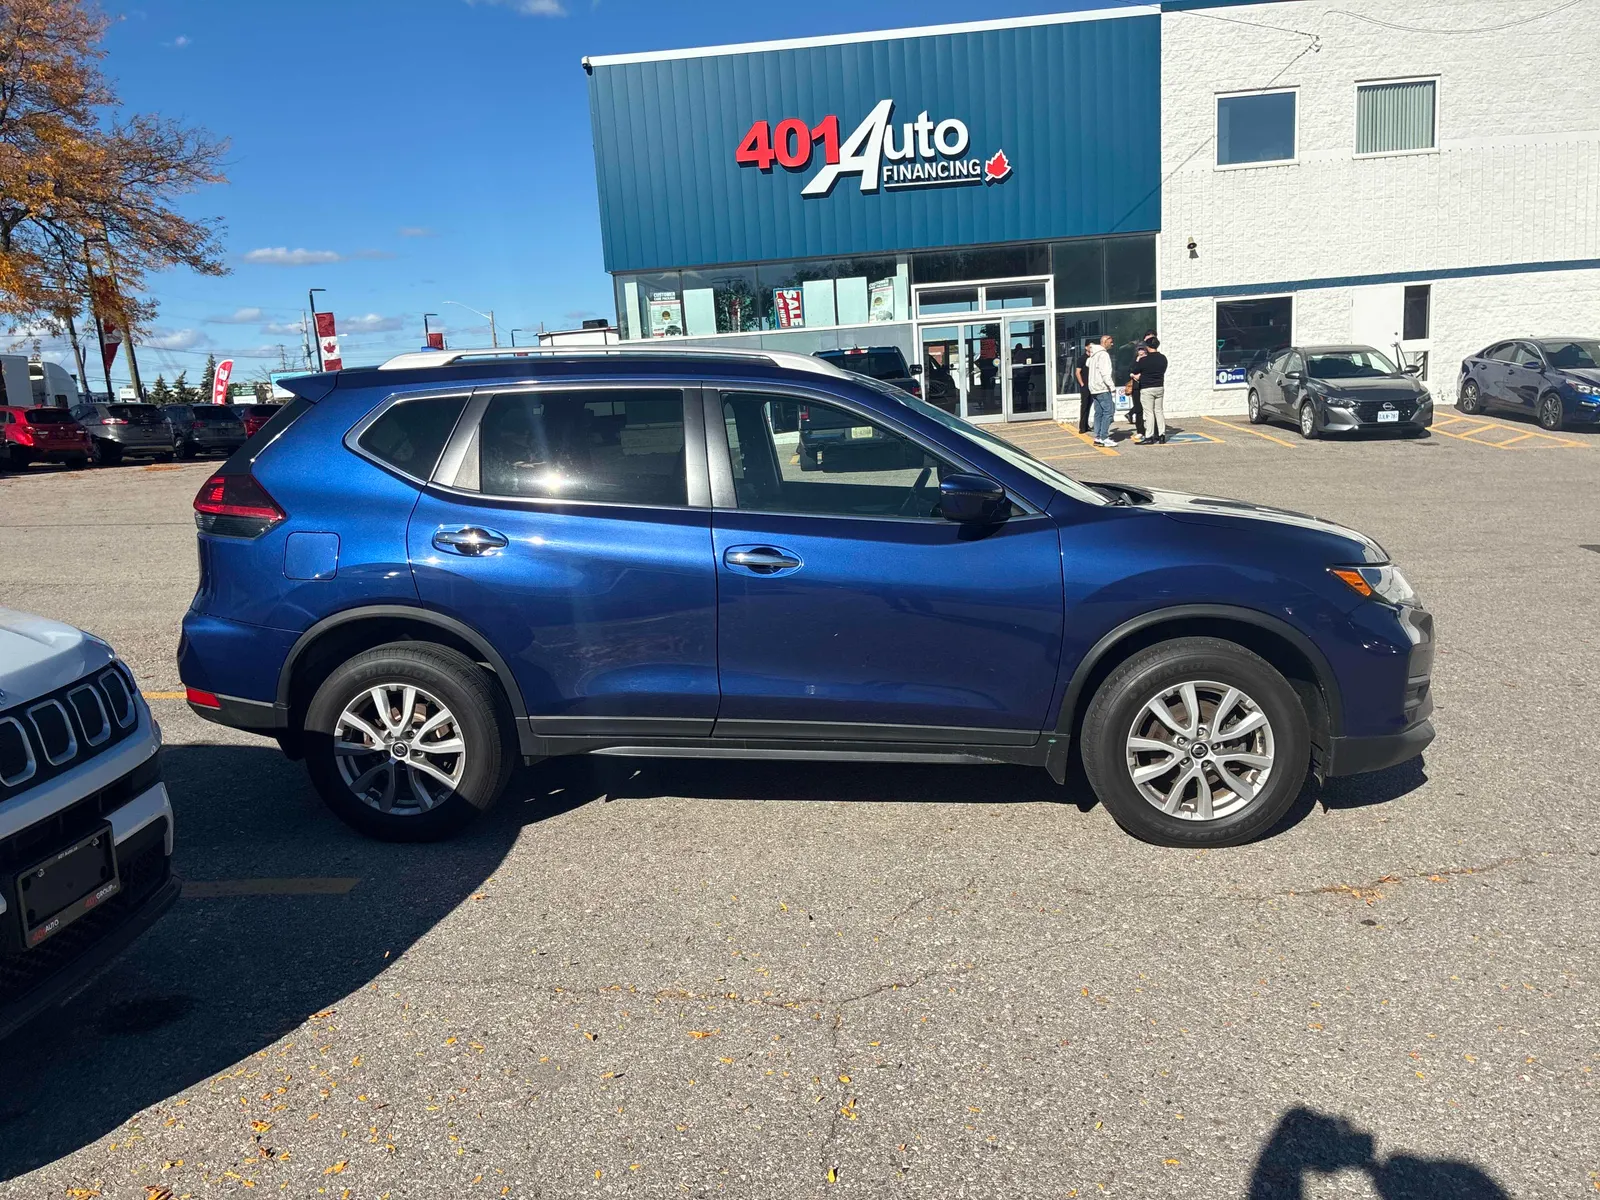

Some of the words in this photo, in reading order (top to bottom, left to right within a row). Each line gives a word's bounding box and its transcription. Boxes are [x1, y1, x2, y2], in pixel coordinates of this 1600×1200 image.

[735, 115, 840, 169] 401
[883, 158, 981, 182] FINANCING
[777, 299, 784, 307] ON
[783, 290, 803, 327] SALE
[216, 367, 229, 404] ALE
